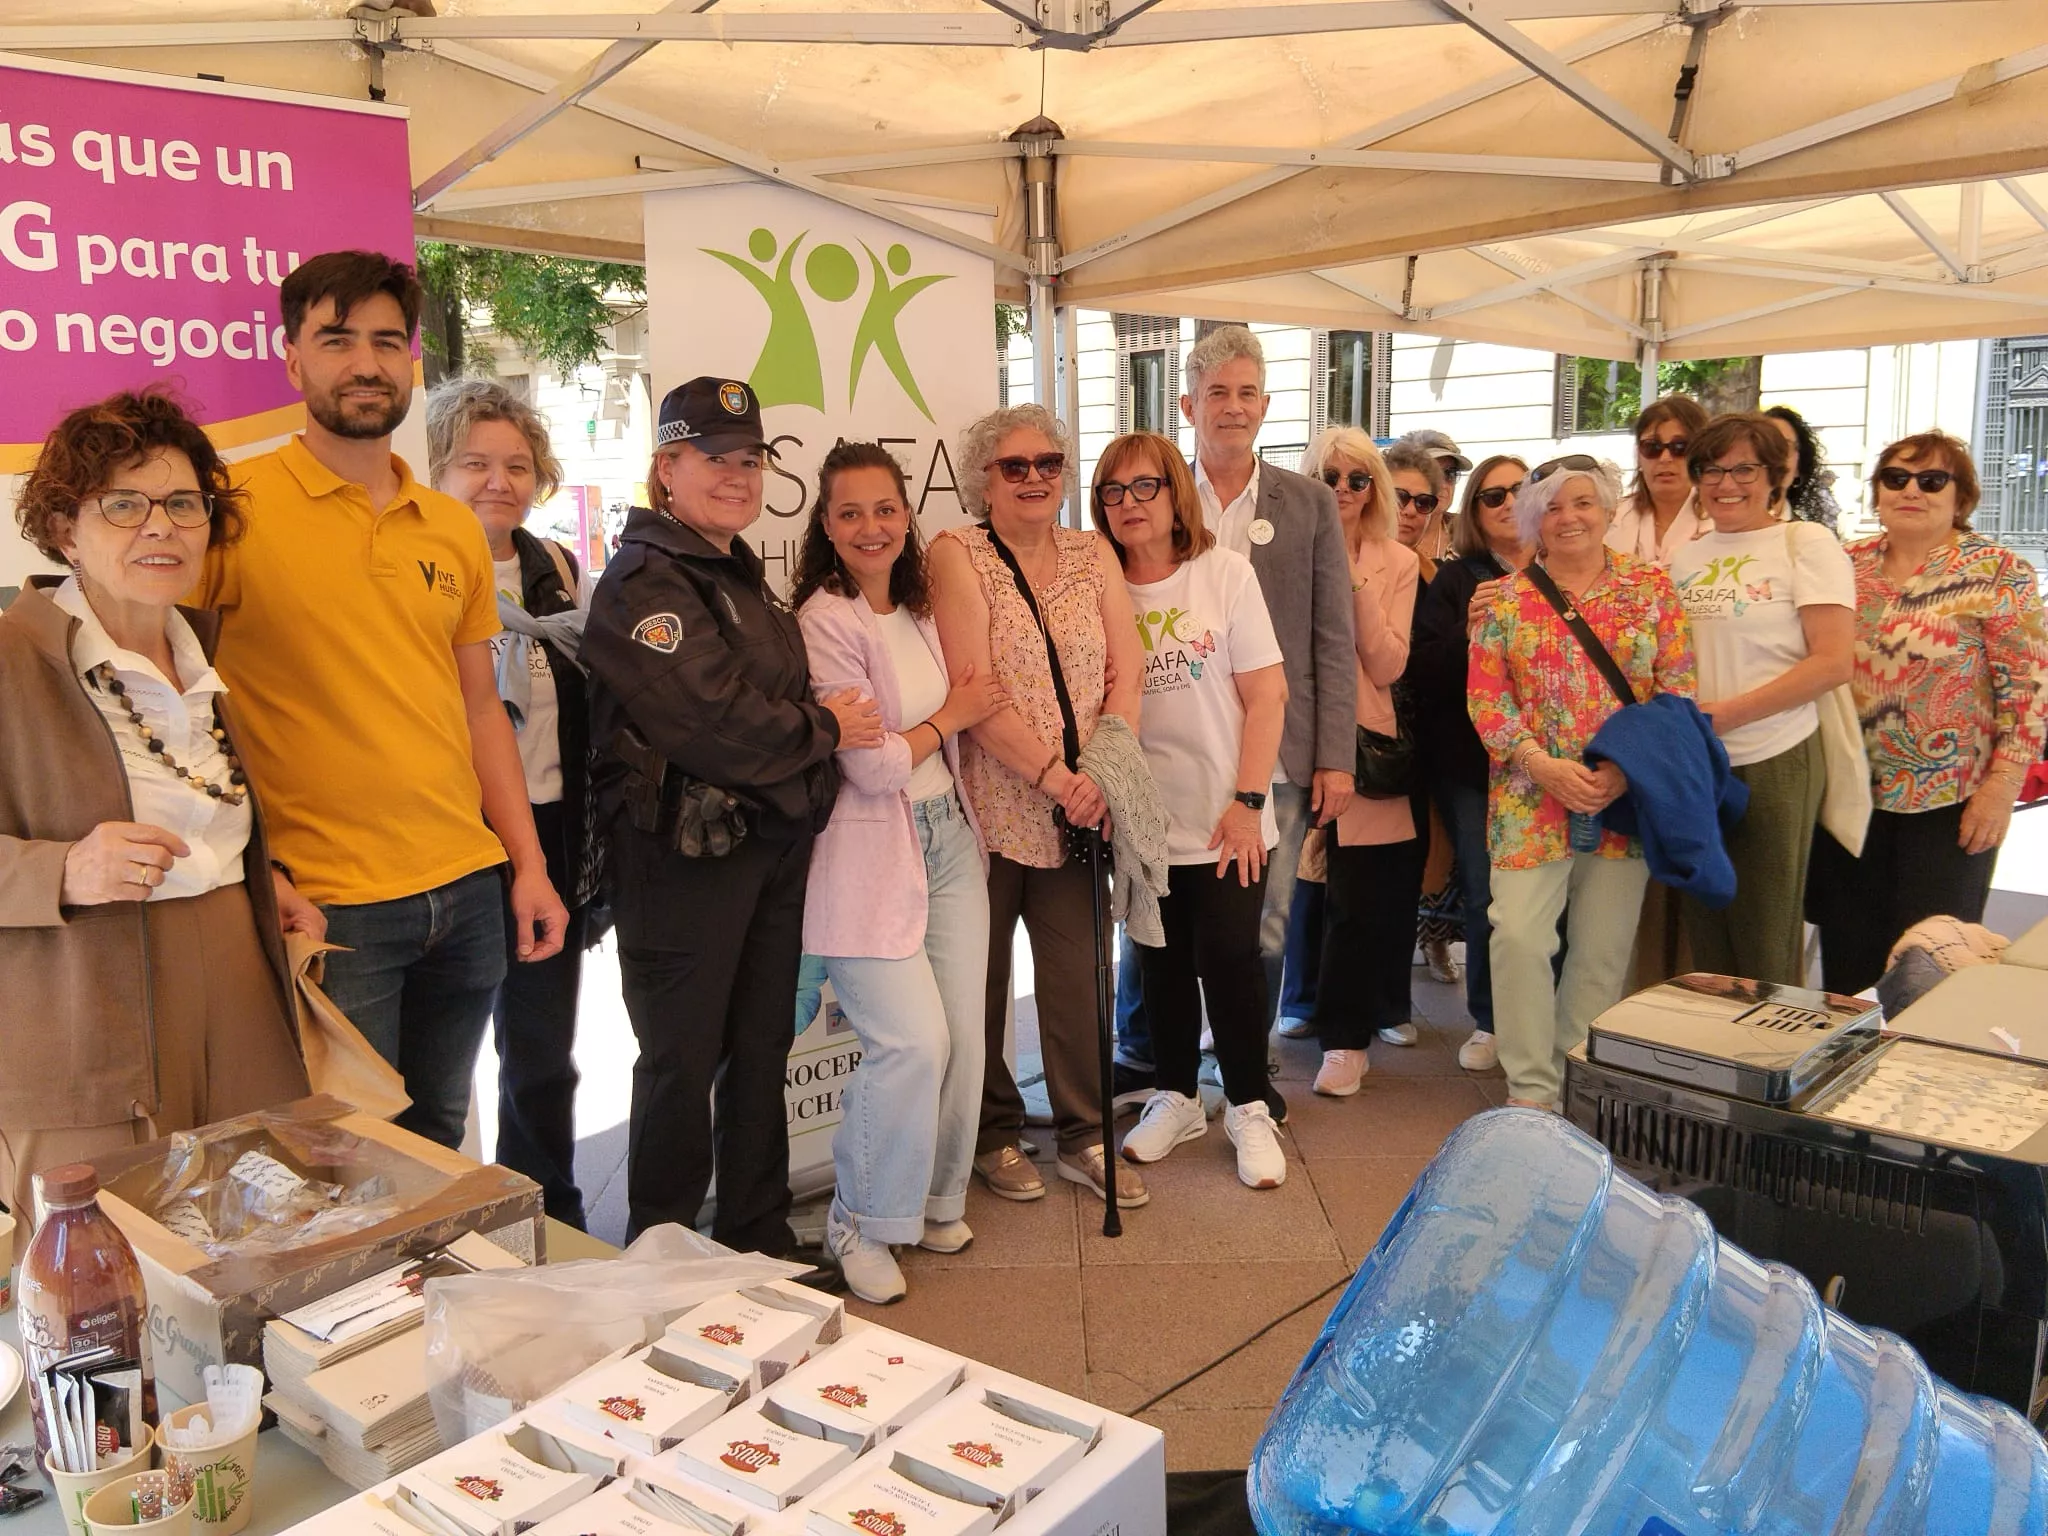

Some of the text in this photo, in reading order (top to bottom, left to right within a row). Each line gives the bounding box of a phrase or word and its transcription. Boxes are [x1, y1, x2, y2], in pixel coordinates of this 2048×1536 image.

[72, 130, 200, 184] que
[215, 146, 293, 191] un
[77, 234, 231, 285] para
[243, 237, 300, 287] tu
[1680, 588, 1737, 603] ASAFA
[1686, 605, 1722, 614] HUESCA
[640, 617, 667, 632] HUESCA
[1144, 672, 1182, 688] UESCA
[91, 1311, 118, 1326] eliges
[831, 1389, 858, 1404] ORUS
[96, 1425, 113, 1458] ORUS
[728, 1443, 773, 1468] ORUS
[961, 1446, 993, 1464] ORUS
[195, 1463, 221, 1476] NOT
[467, 1480, 494, 1497] ORUS
[863, 1514, 894, 1535] ORUS
